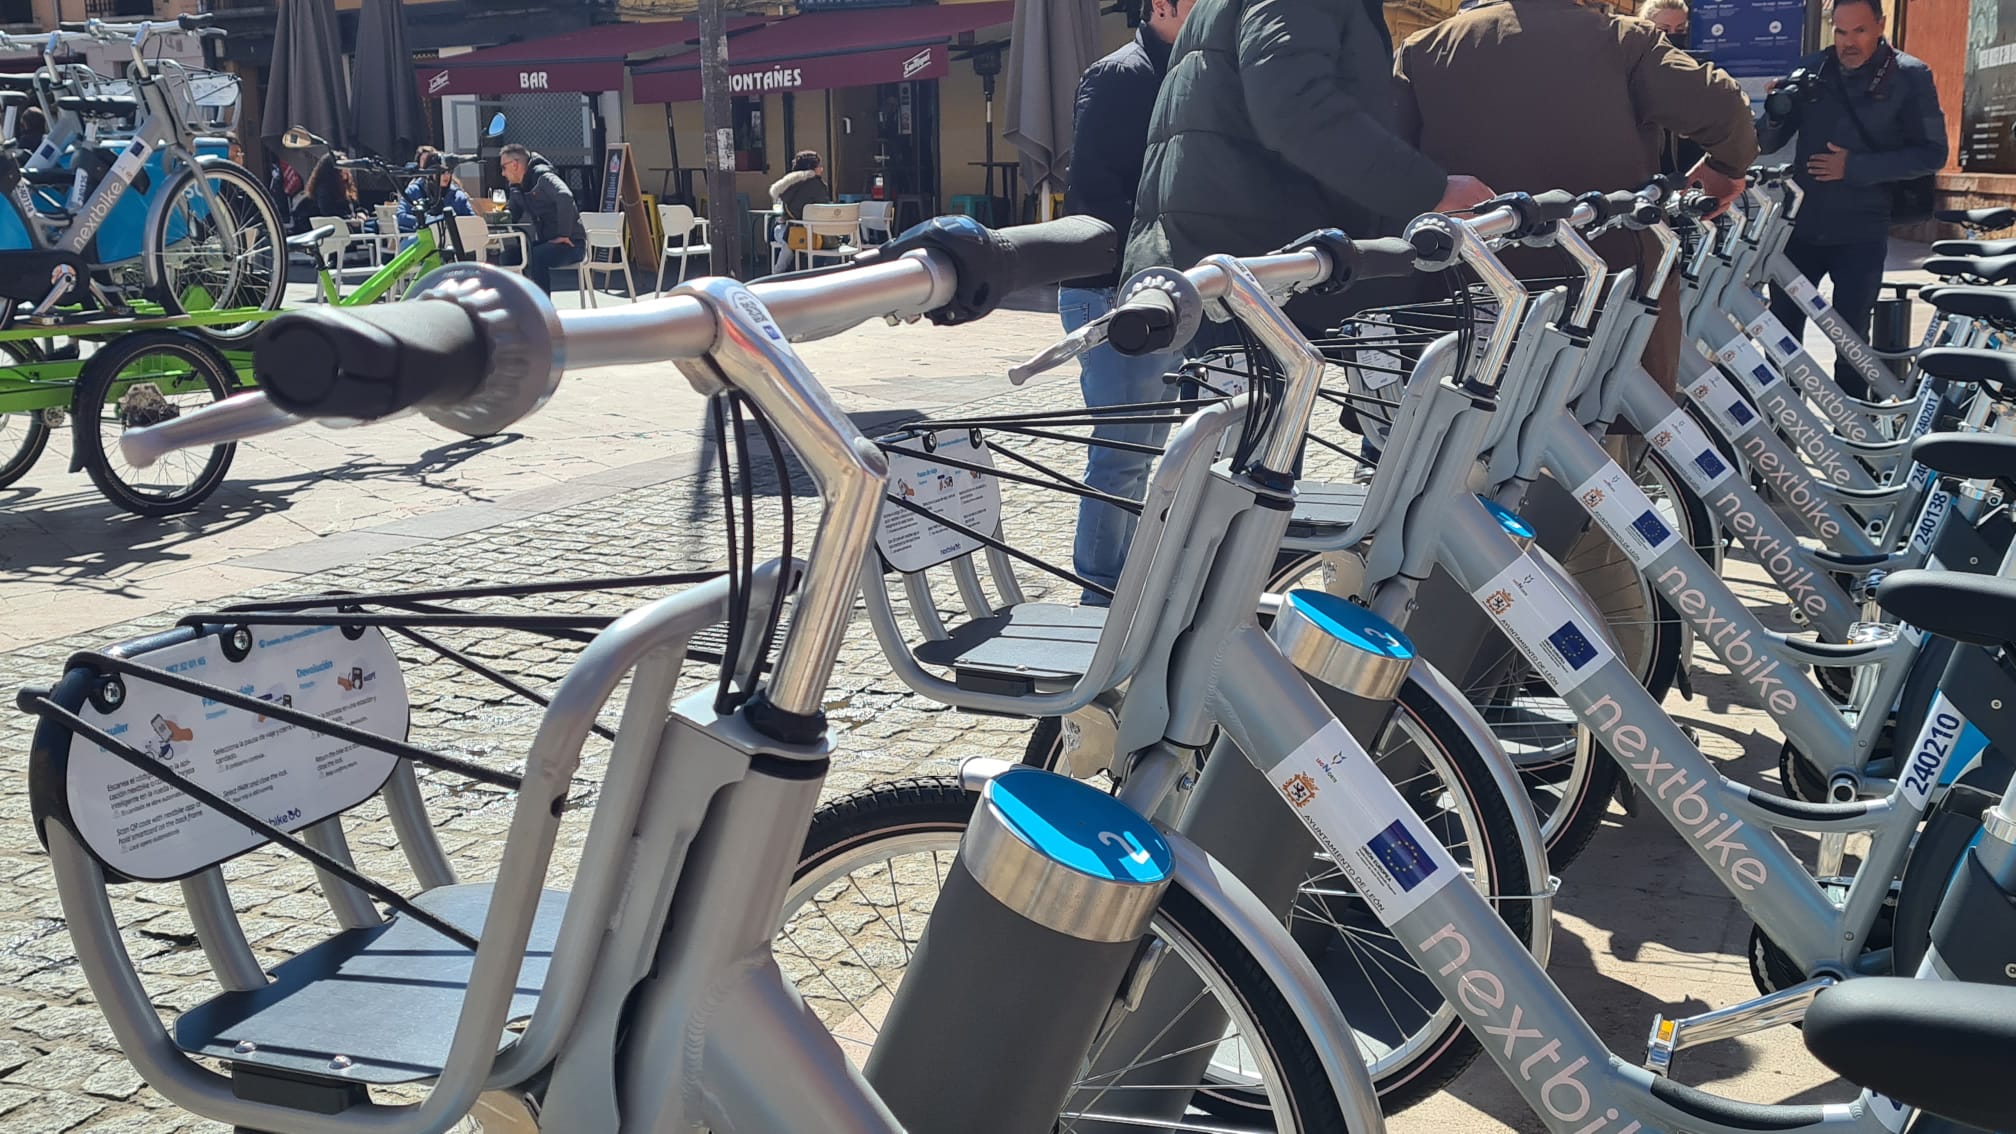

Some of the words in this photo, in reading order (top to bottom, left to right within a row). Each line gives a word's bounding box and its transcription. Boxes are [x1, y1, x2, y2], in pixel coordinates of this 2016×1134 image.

[519, 71, 548, 89] BAR
[73, 182, 122, 249] nextbike
[1822, 317, 1880, 382] nextbike
[1768, 395, 1850, 485] nextbike
[1794, 364, 1867, 442] nextbike
[1914, 398, 1937, 436] 240201
[1745, 436, 1840, 538] nextbike
[1915, 493, 1948, 546] 240138
[1716, 492, 1827, 616] nextbike
[1500, 619, 1538, 661] AYUNTAMIENTO
[1658, 566, 1797, 715] nextbike
[1584, 694, 1767, 890] nextbike
[1905, 713, 1960, 796] 240210
[1303, 814, 1356, 877] AYUNTAMIENTO
[1354, 873, 1367, 889] DE
[1364, 888, 1385, 912] LEÓN
[1418, 922, 1642, 1134] nextbik
